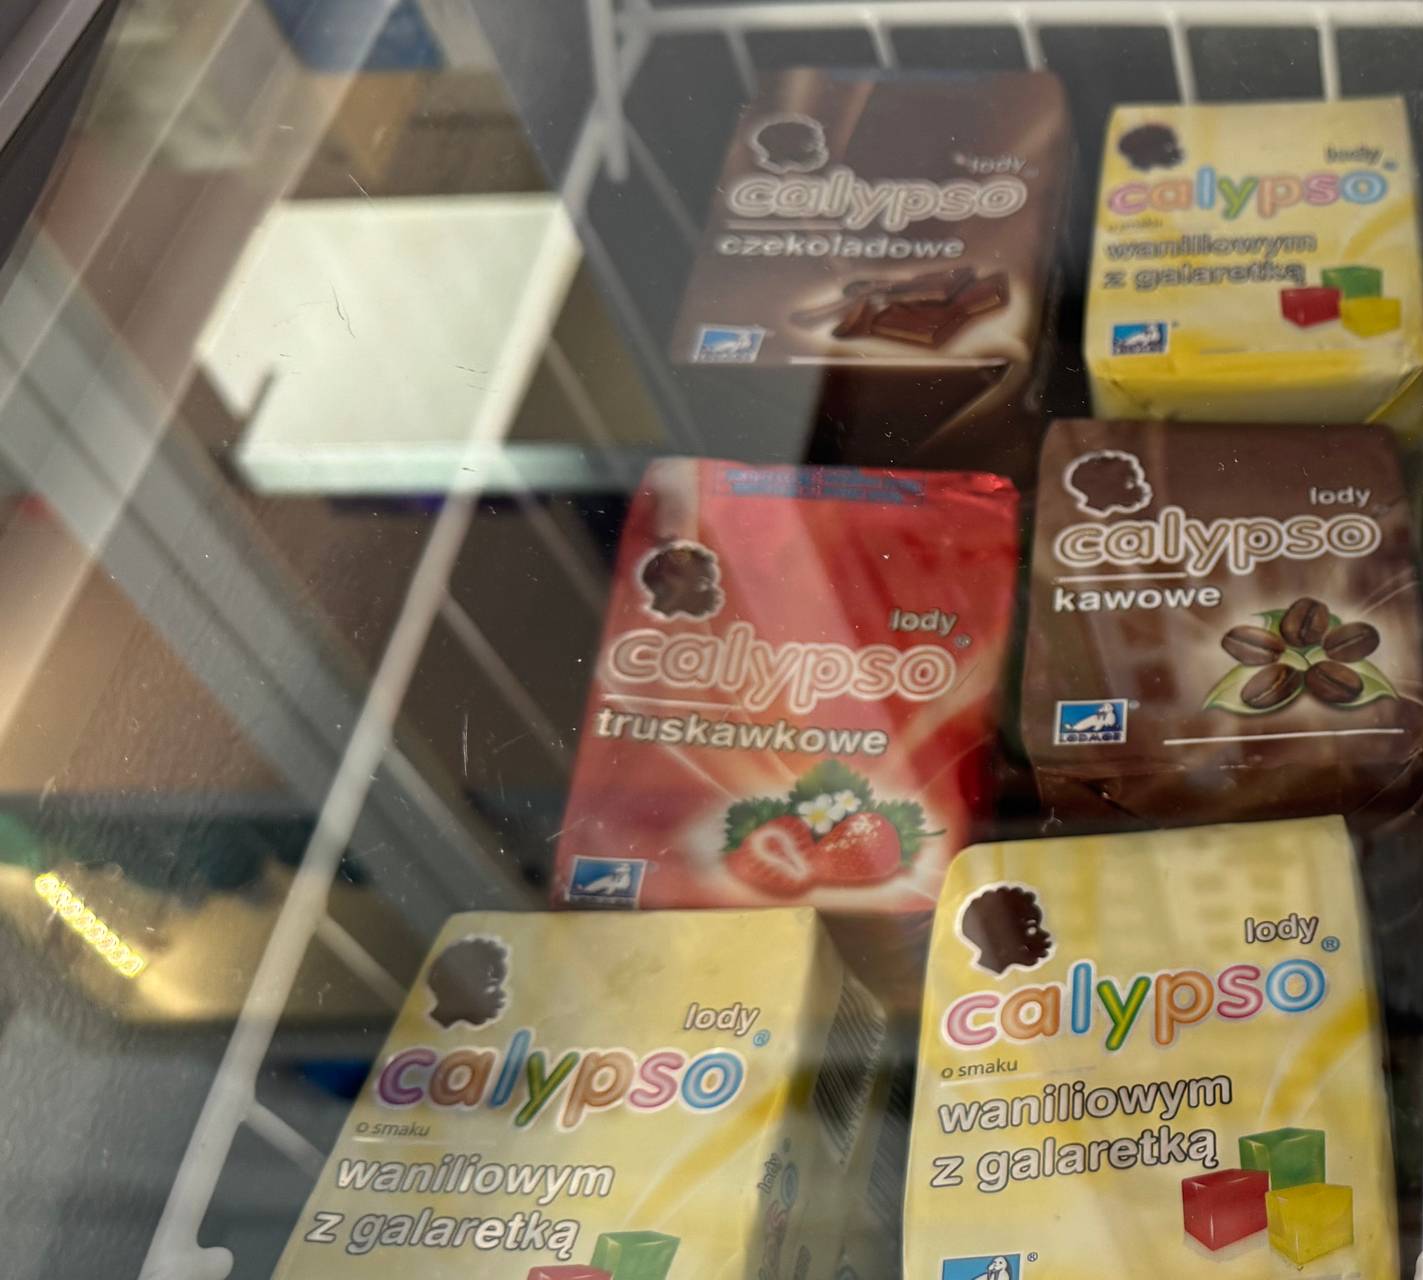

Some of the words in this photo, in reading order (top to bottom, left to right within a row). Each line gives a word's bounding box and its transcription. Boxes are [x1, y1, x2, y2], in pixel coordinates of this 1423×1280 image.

[727, 166, 1028, 232] calypso
[1107, 165, 1388, 220] calypso
[719, 235, 966, 259] czekoladowe
[1309, 486, 1371, 507] lody
[1053, 506, 1382, 575] calypso
[889, 608, 958, 635] lody
[1052, 585, 1221, 613] kawowe
[608, 621, 957, 716] calypso
[596, 707, 889, 755] truskawkowe
[1244, 913, 1319, 945] lody
[683, 1002, 760, 1038] lody
[942, 958, 1329, 1052] calypso
[376, 1027, 748, 1133] calypso
[942, 1066, 953, 1079] o
[958, 1057, 1018, 1077] smaku
[355, 1121, 369, 1135] o
[372, 1119, 432, 1139] smaku
[937, 1074, 1232, 1134] waniliowym
[336, 1152, 615, 1206] waniliowym
[930, 1155, 964, 1189] z
[976, 1126, 1219, 1193] galaretką
[305, 1211, 343, 1245] z
[347, 1207, 580, 1260] galaretką
